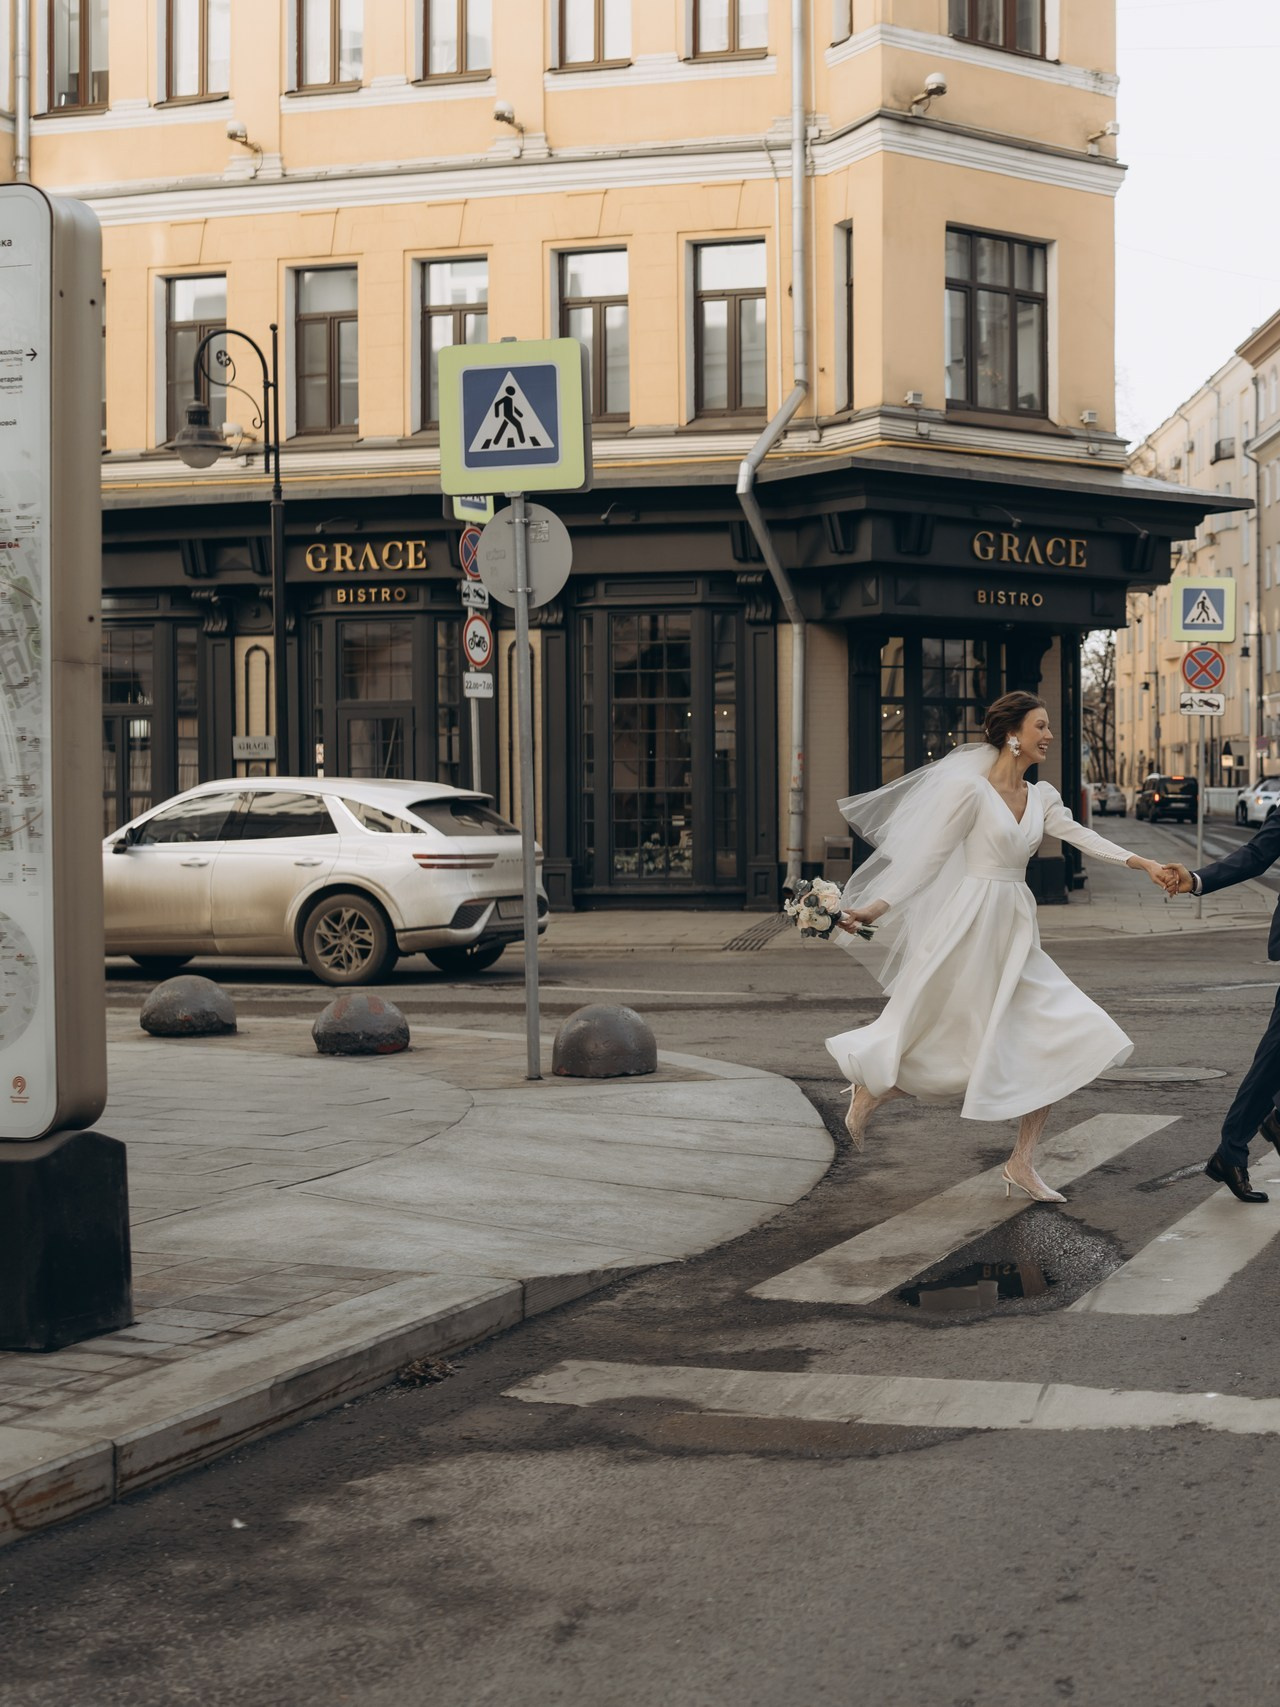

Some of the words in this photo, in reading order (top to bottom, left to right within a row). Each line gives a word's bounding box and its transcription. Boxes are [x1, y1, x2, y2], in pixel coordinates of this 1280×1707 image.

[0, 239, 13, 247] ка
[305, 540, 427, 572] GRACE
[973, 530, 1087, 568] GRACE
[337, 587, 406, 603] BISTRO
[977, 590, 1044, 607] BISTRO
[238, 742, 270, 751] GRACE
